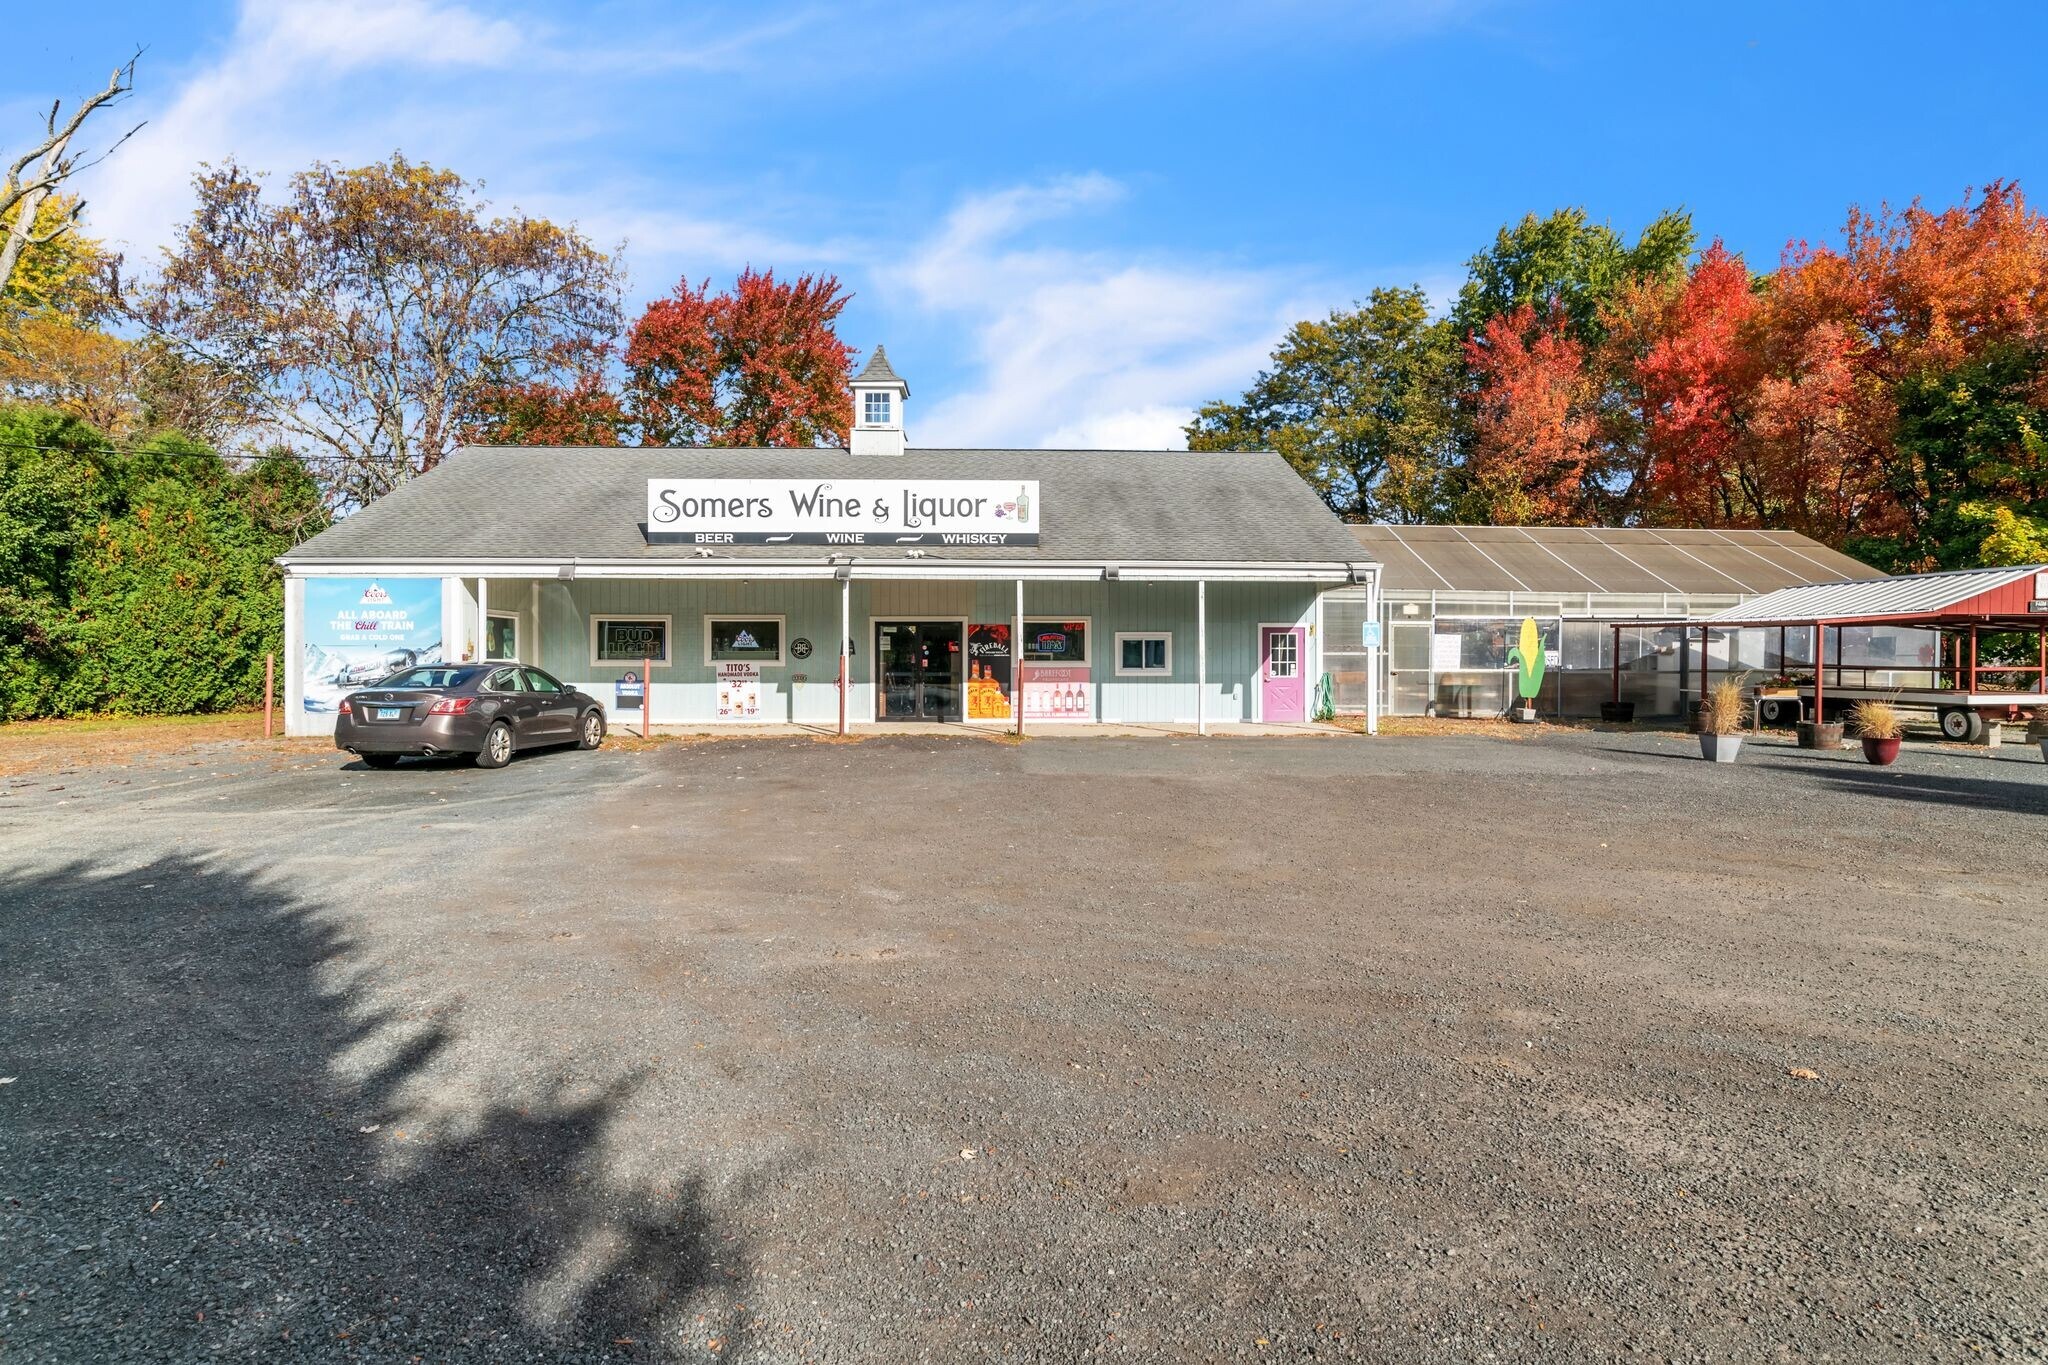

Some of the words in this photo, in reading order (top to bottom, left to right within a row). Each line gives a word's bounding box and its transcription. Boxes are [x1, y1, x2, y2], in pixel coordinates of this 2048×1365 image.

[653, 489, 773, 523] Somers
[788, 483, 861, 518] Wine
[872, 498, 890, 524] &
[903, 489, 988, 528] Liquor
[695, 533, 734, 543] BEER
[826, 533, 865, 544] WINE
[942, 534, 1008, 544] WHISKEY
[337, 610, 358, 620] ALL
[361, 610, 408, 620] ABOARD
[330, 621, 352, 631] THE
[354, 621, 378, 631] Chill
[381, 621, 415, 631] TRAIN
[368, 633, 389, 641] COLD
[389, 633, 405, 641] ONE
[615, 629, 653, 642] BUD
[979, 642, 1010, 654] FIREBALL
